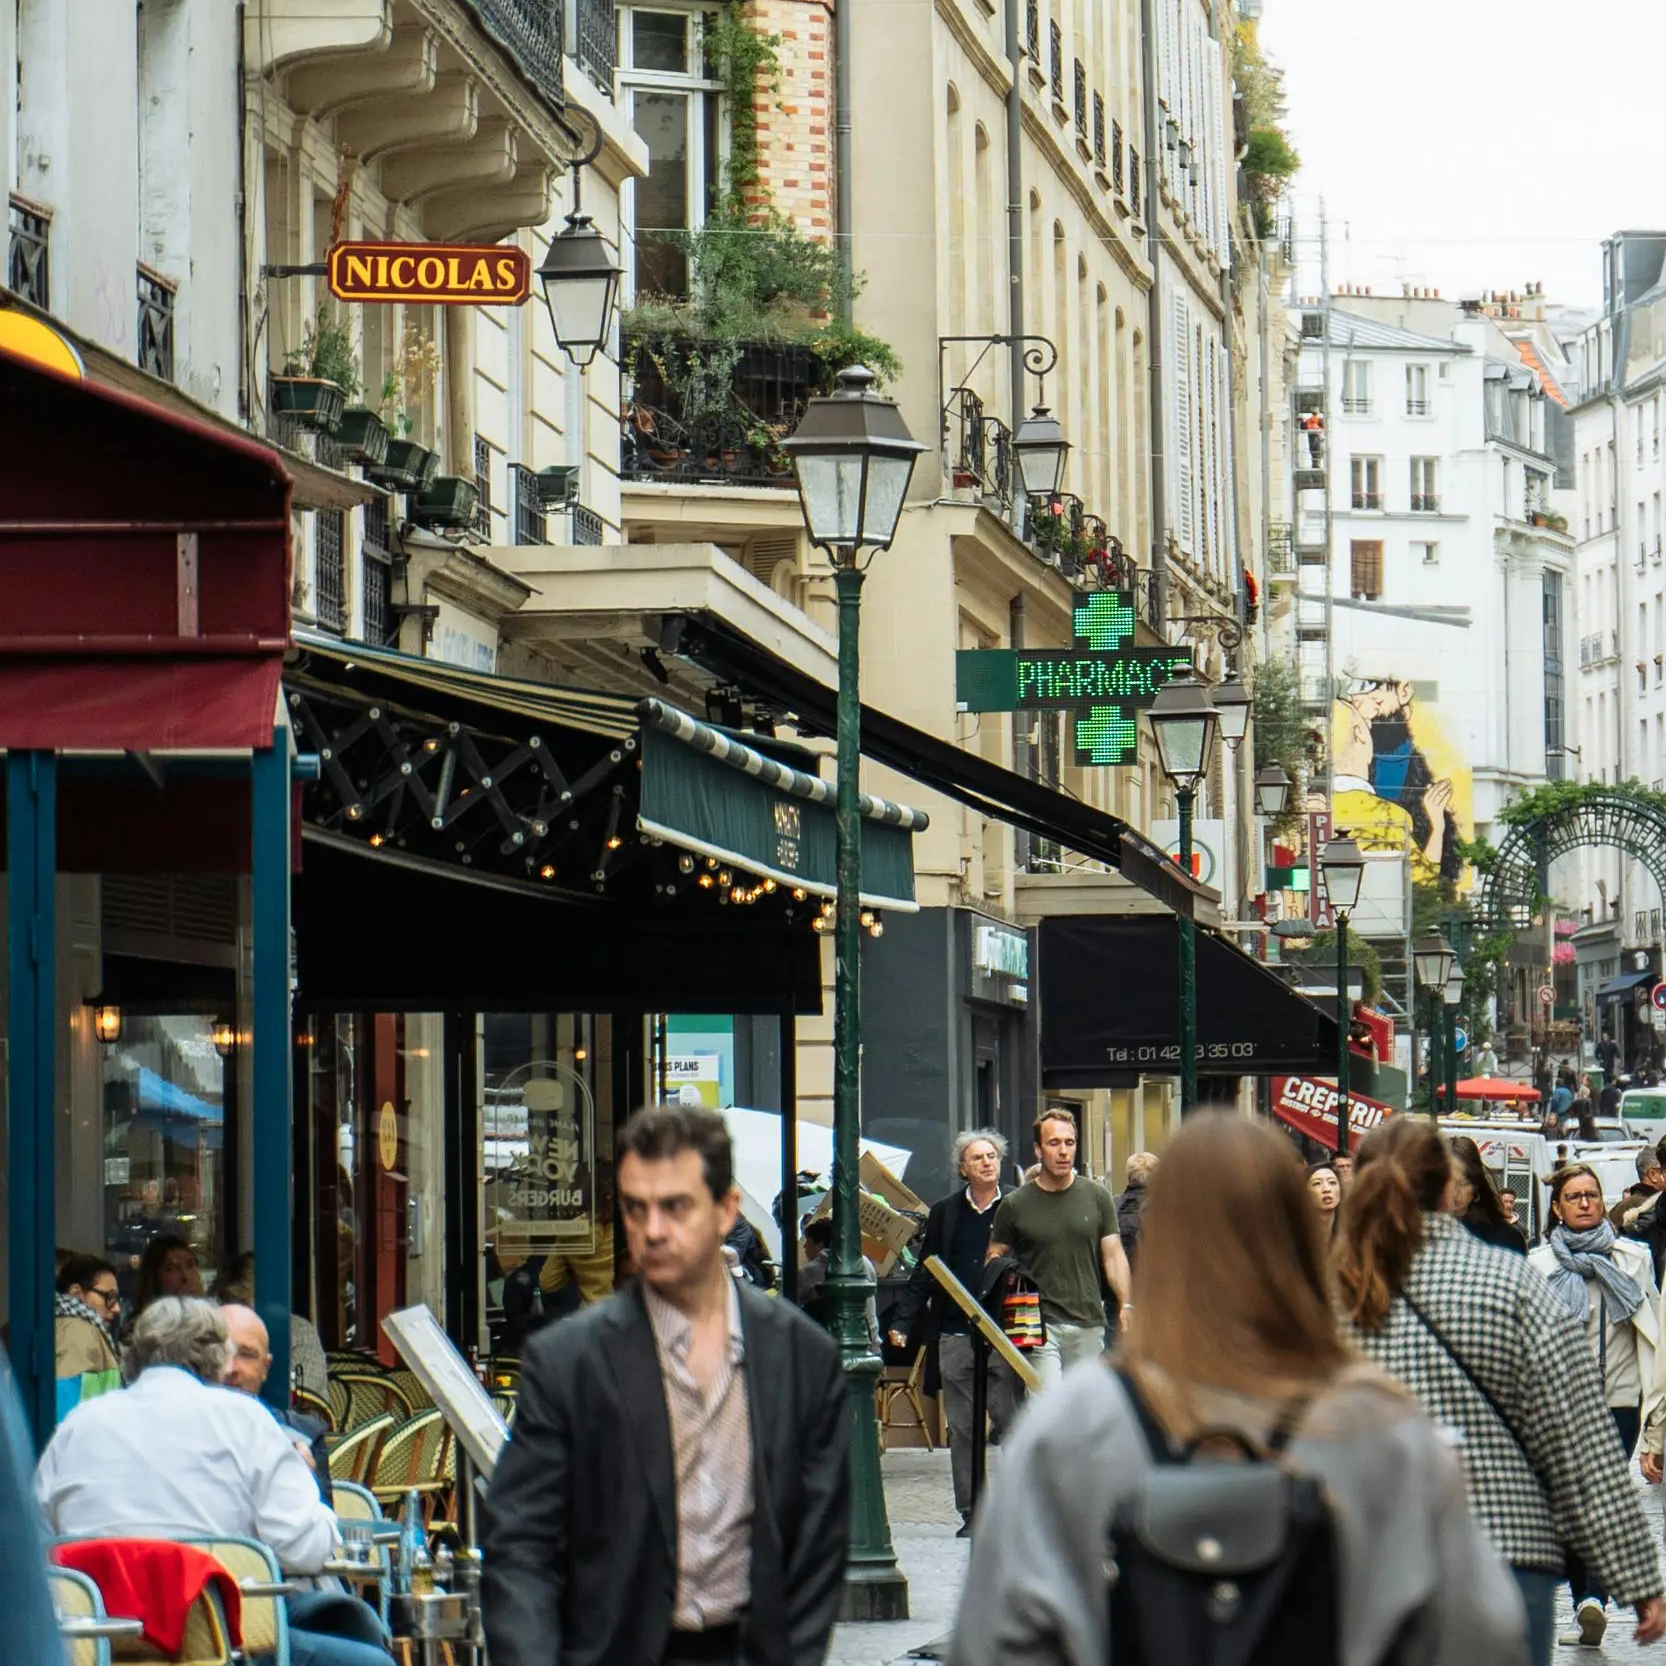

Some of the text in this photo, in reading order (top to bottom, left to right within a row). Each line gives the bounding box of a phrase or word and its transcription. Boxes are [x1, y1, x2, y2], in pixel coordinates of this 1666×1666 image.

[345, 256, 516, 290] NICOLAS
[1316, 815, 1330, 926] PIZRIA
[674, 1060, 700, 1072] PLANS
[1138, 1046, 1156, 1061] 01
[1160, 1045, 1181, 1059] 42
[1283, 1076, 1384, 1128] CREPRI
